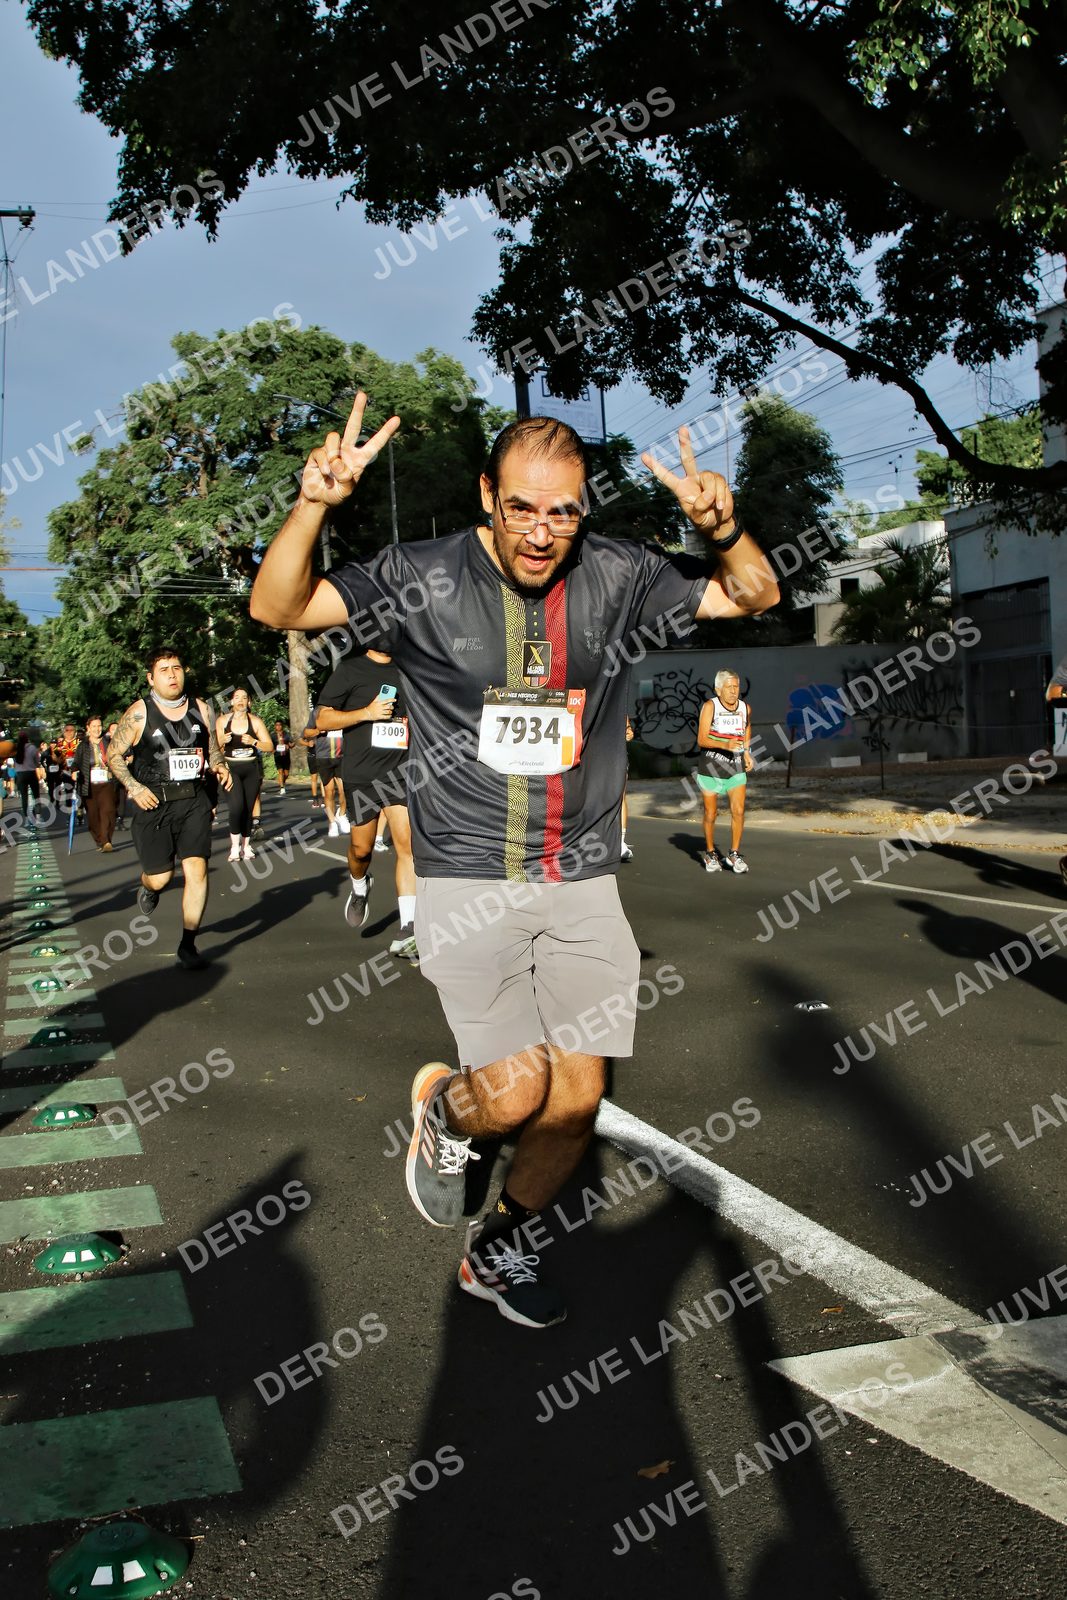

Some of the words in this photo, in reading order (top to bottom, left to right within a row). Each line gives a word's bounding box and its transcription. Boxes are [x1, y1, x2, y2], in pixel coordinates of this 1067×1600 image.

[653, 668, 693, 683] TOY
[569, 697, 581, 706] 10K
[376, 725, 405, 737] 13009
[496, 716, 560, 745] 7934
[173, 759, 200, 769] 10169
